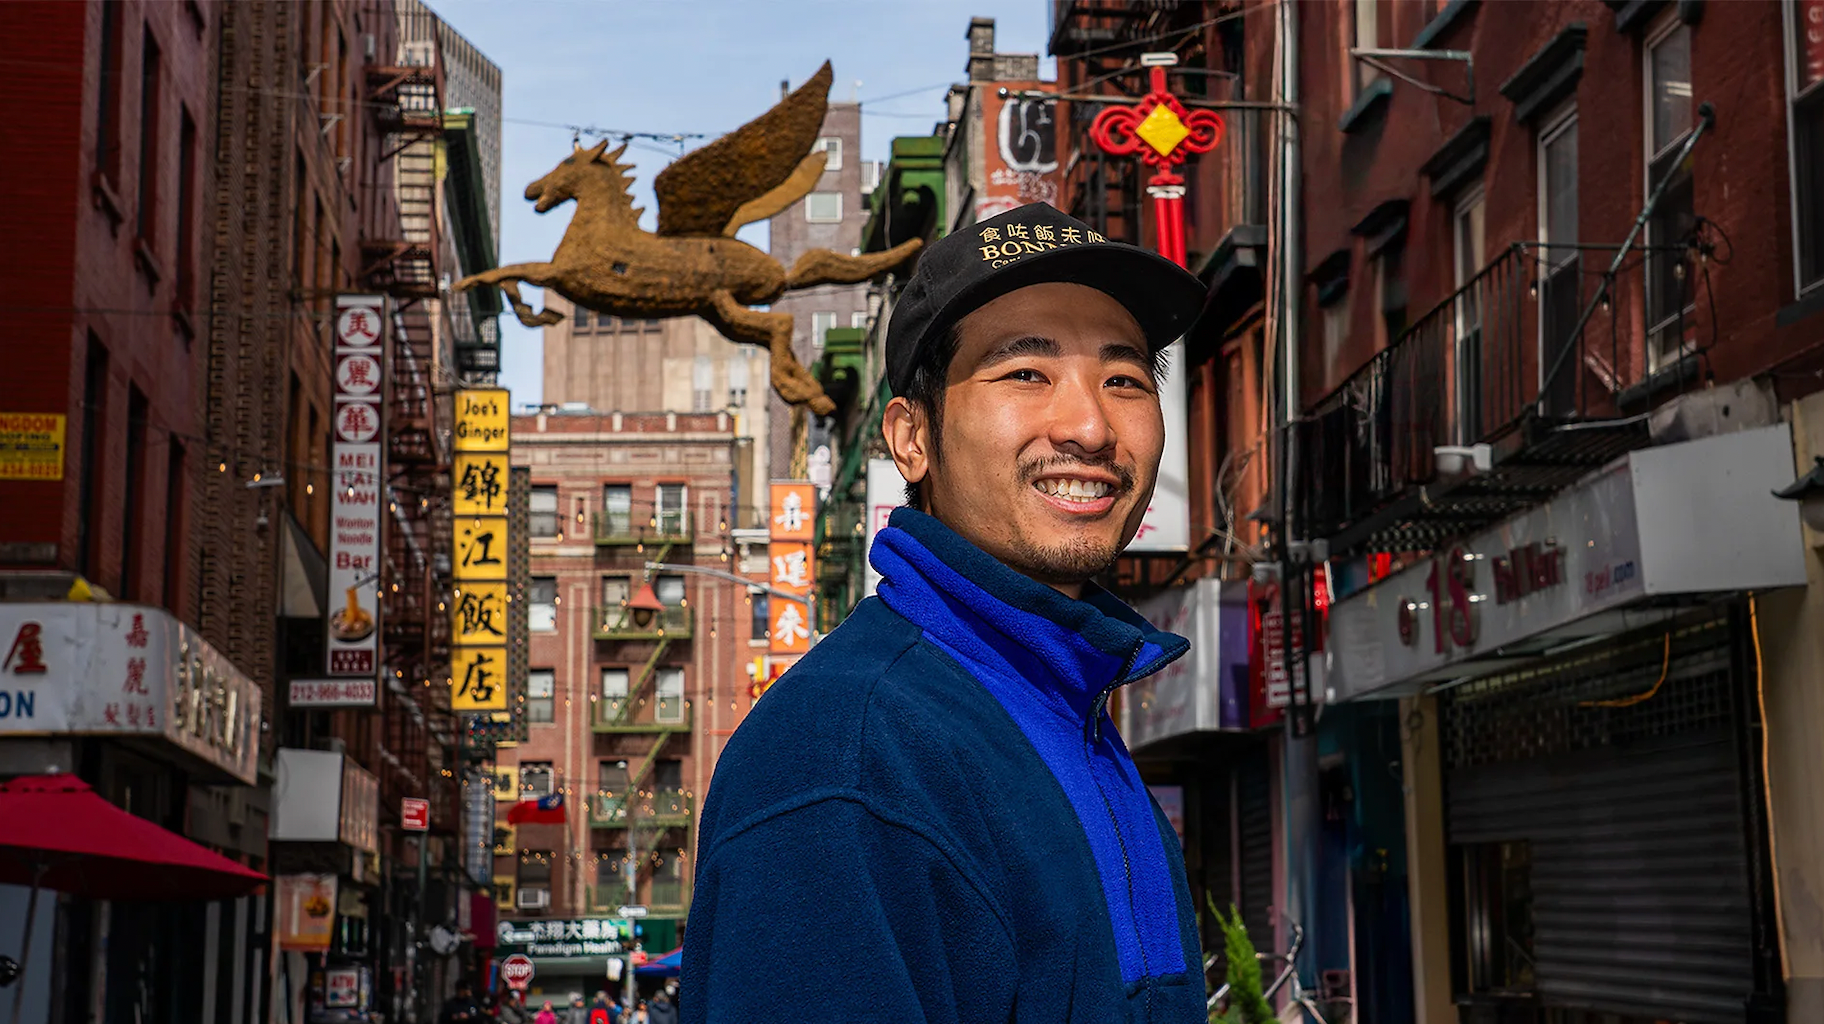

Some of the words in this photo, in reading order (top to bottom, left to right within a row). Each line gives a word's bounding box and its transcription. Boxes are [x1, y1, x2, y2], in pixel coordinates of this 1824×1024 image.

[344, 310, 375, 438] 美麗華
[465, 398, 498, 416] Joe's
[458, 421, 504, 442] Ginger
[340, 453, 374, 467] MEI
[341, 472, 373, 486] LAI
[338, 490, 376, 505] WAH
[337, 532, 373, 545] Noodle
[336, 551, 371, 570] Bar
[458, 461, 504, 702] 錦江飯店
[505, 963, 532, 977] STOP
